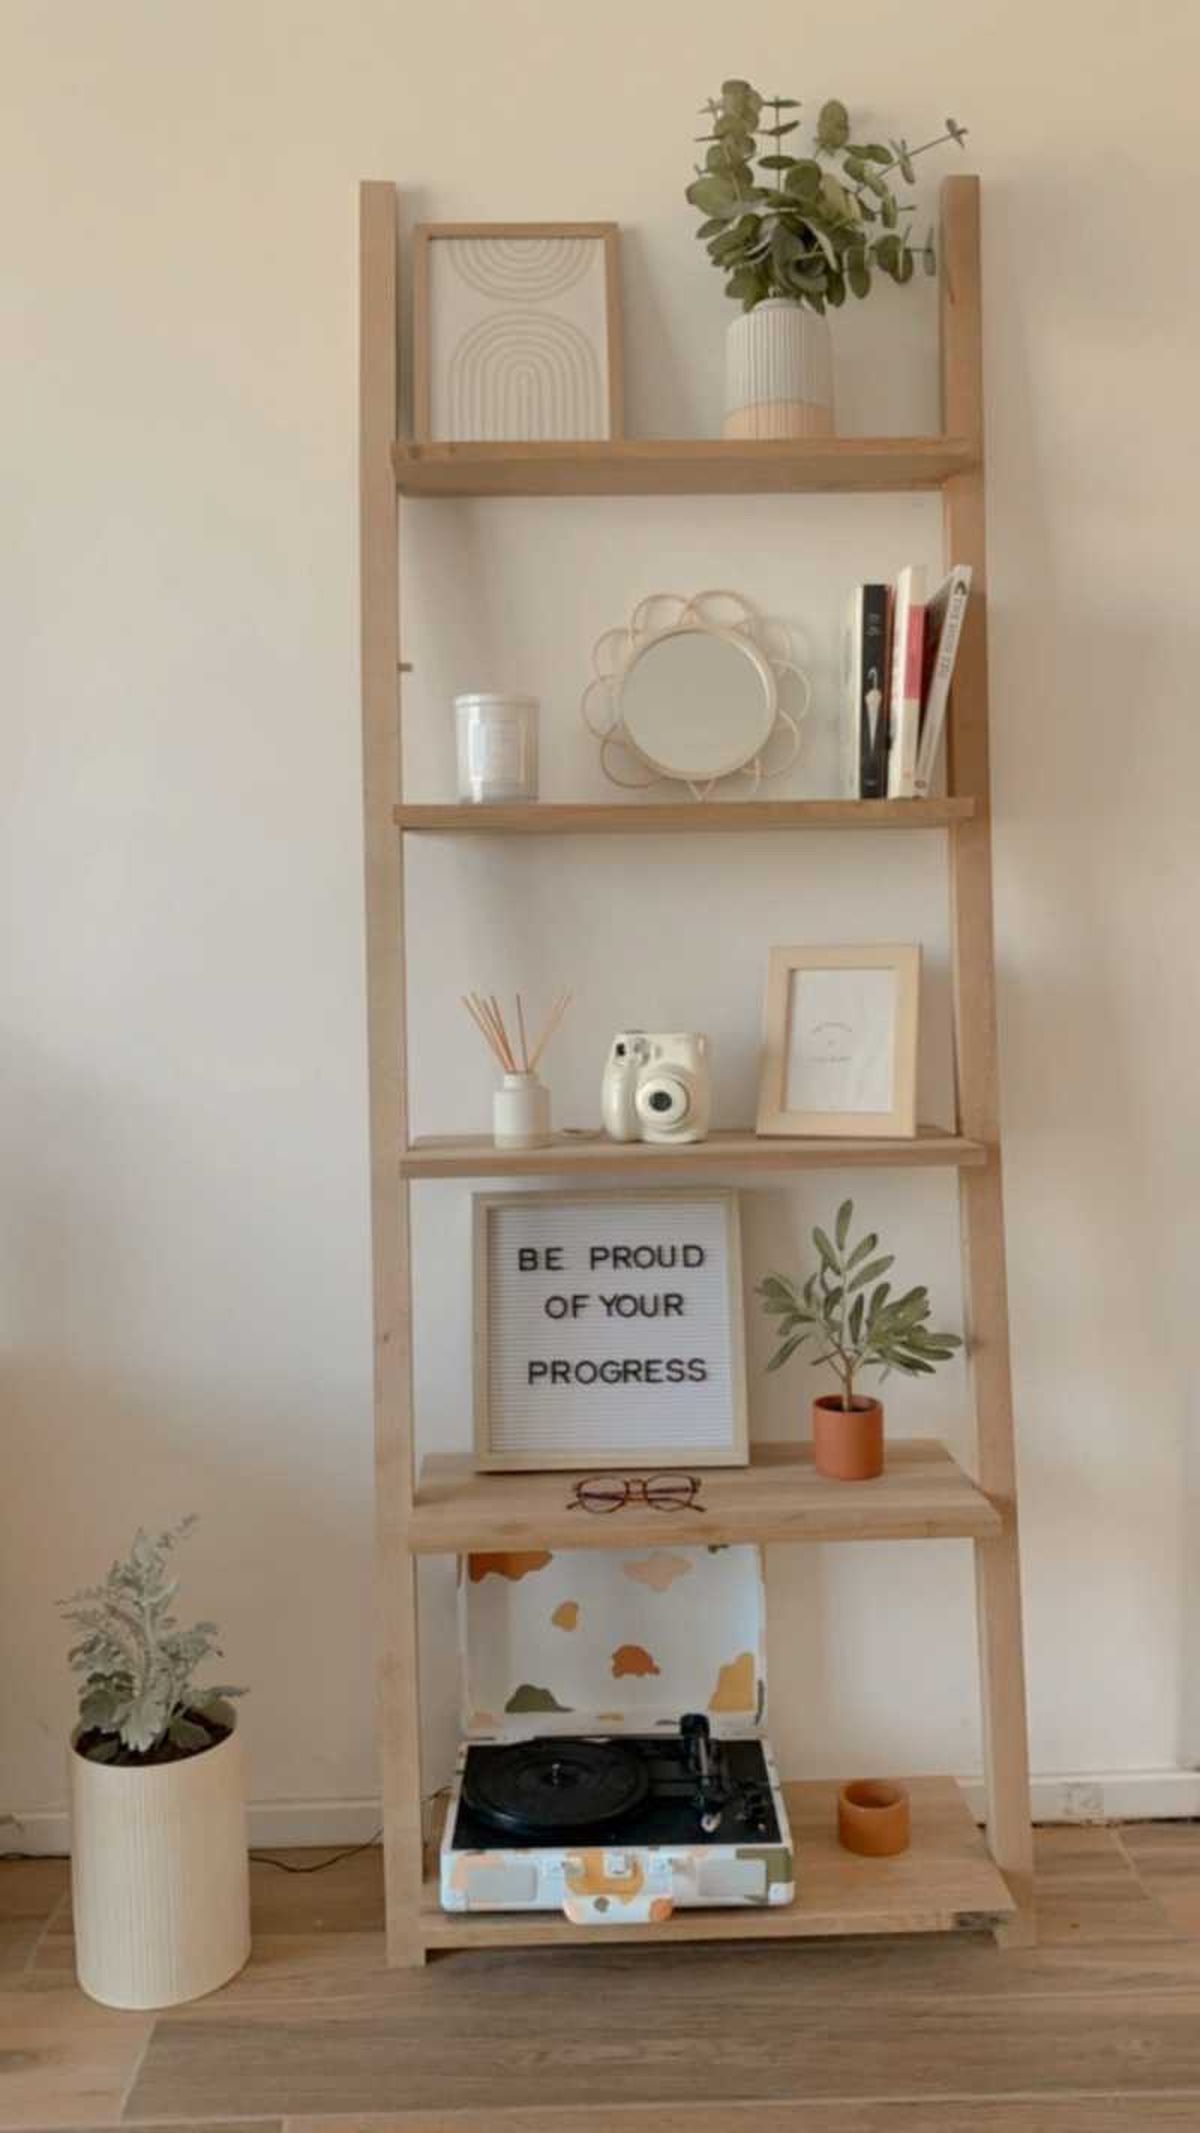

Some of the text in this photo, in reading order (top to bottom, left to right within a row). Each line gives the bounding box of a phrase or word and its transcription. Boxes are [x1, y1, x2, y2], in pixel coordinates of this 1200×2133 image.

[518, 1244, 706, 1272] BE PROUD
[545, 1293, 685, 1320] OF YOUR
[527, 1358, 707, 1385] PROGRESS
